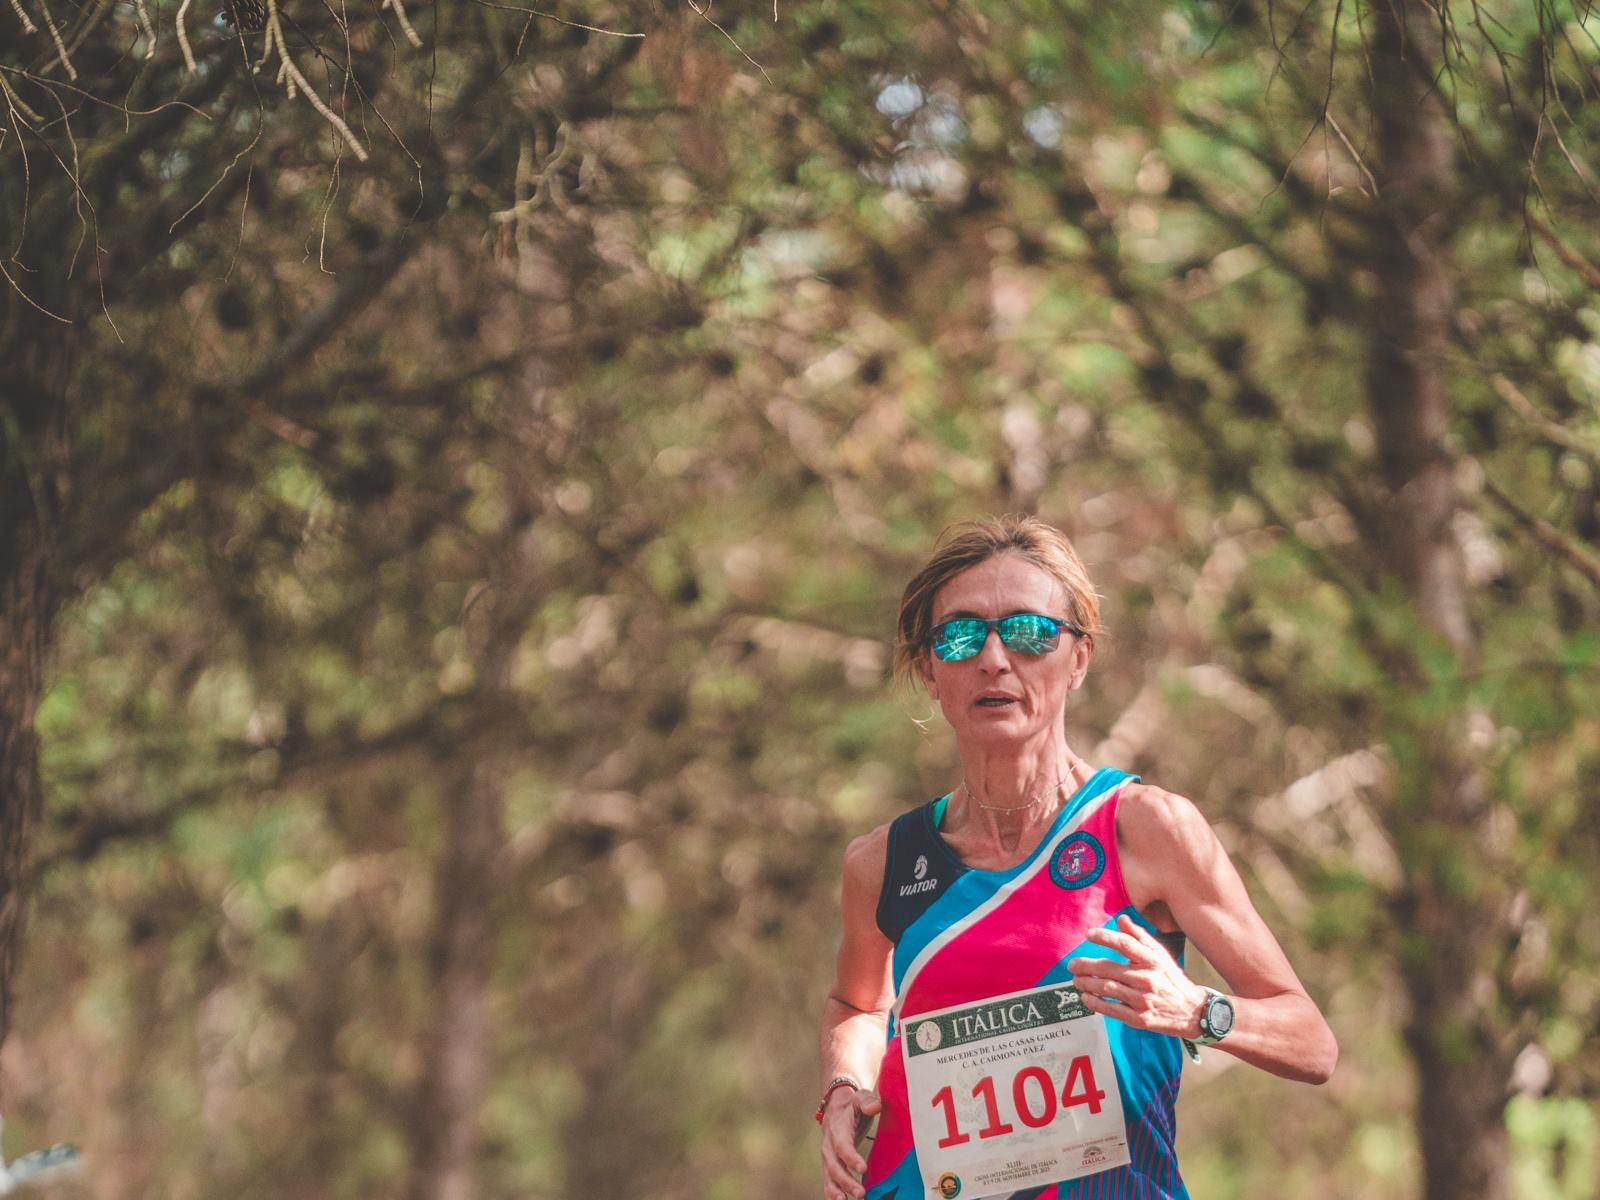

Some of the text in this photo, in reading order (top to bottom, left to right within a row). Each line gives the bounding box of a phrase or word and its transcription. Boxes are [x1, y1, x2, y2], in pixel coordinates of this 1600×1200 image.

[899, 878, 938, 897] VIATOR
[952, 1001, 1044, 1039] ITÁLICA
[1059, 1010, 1083, 1020] Sevilla
[936, 1027, 1071, 1064] MERCEDES DE LAS CASAS GARCÍA
[972, 1059, 980, 1067] A.
[980, 1050, 1021, 1065] CARMONA
[931, 1055, 1106, 1149] 1104
